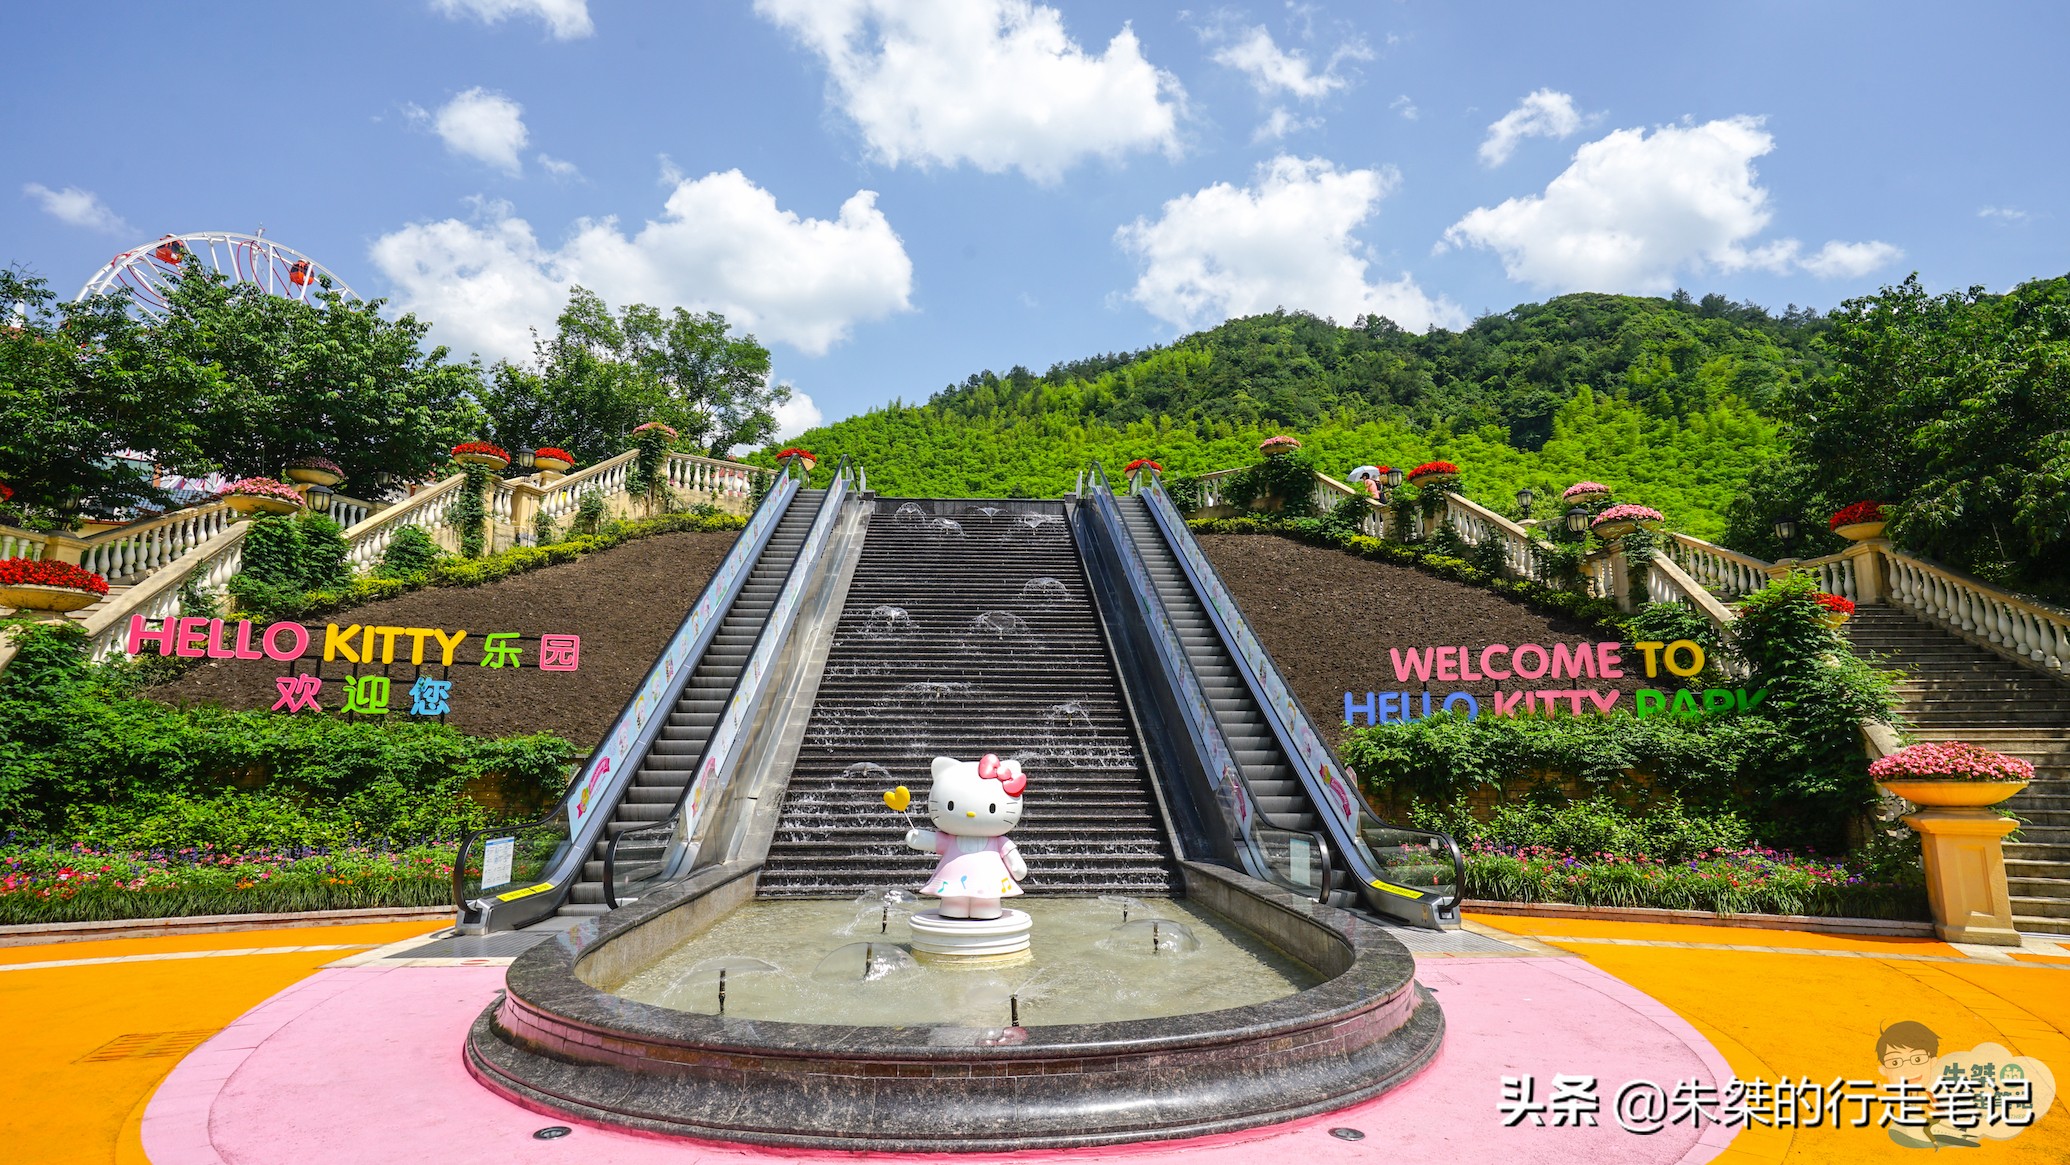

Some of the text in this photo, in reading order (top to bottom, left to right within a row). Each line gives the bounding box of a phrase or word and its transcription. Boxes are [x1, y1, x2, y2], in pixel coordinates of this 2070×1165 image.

[127, 614, 581, 672] HELLO KITTY 乐园
[1390, 639, 1706, 682] WELCOME TO
[271, 674, 452, 715] 欢迎您
[1343, 688, 1769, 727] HELLO KITTY PARK
